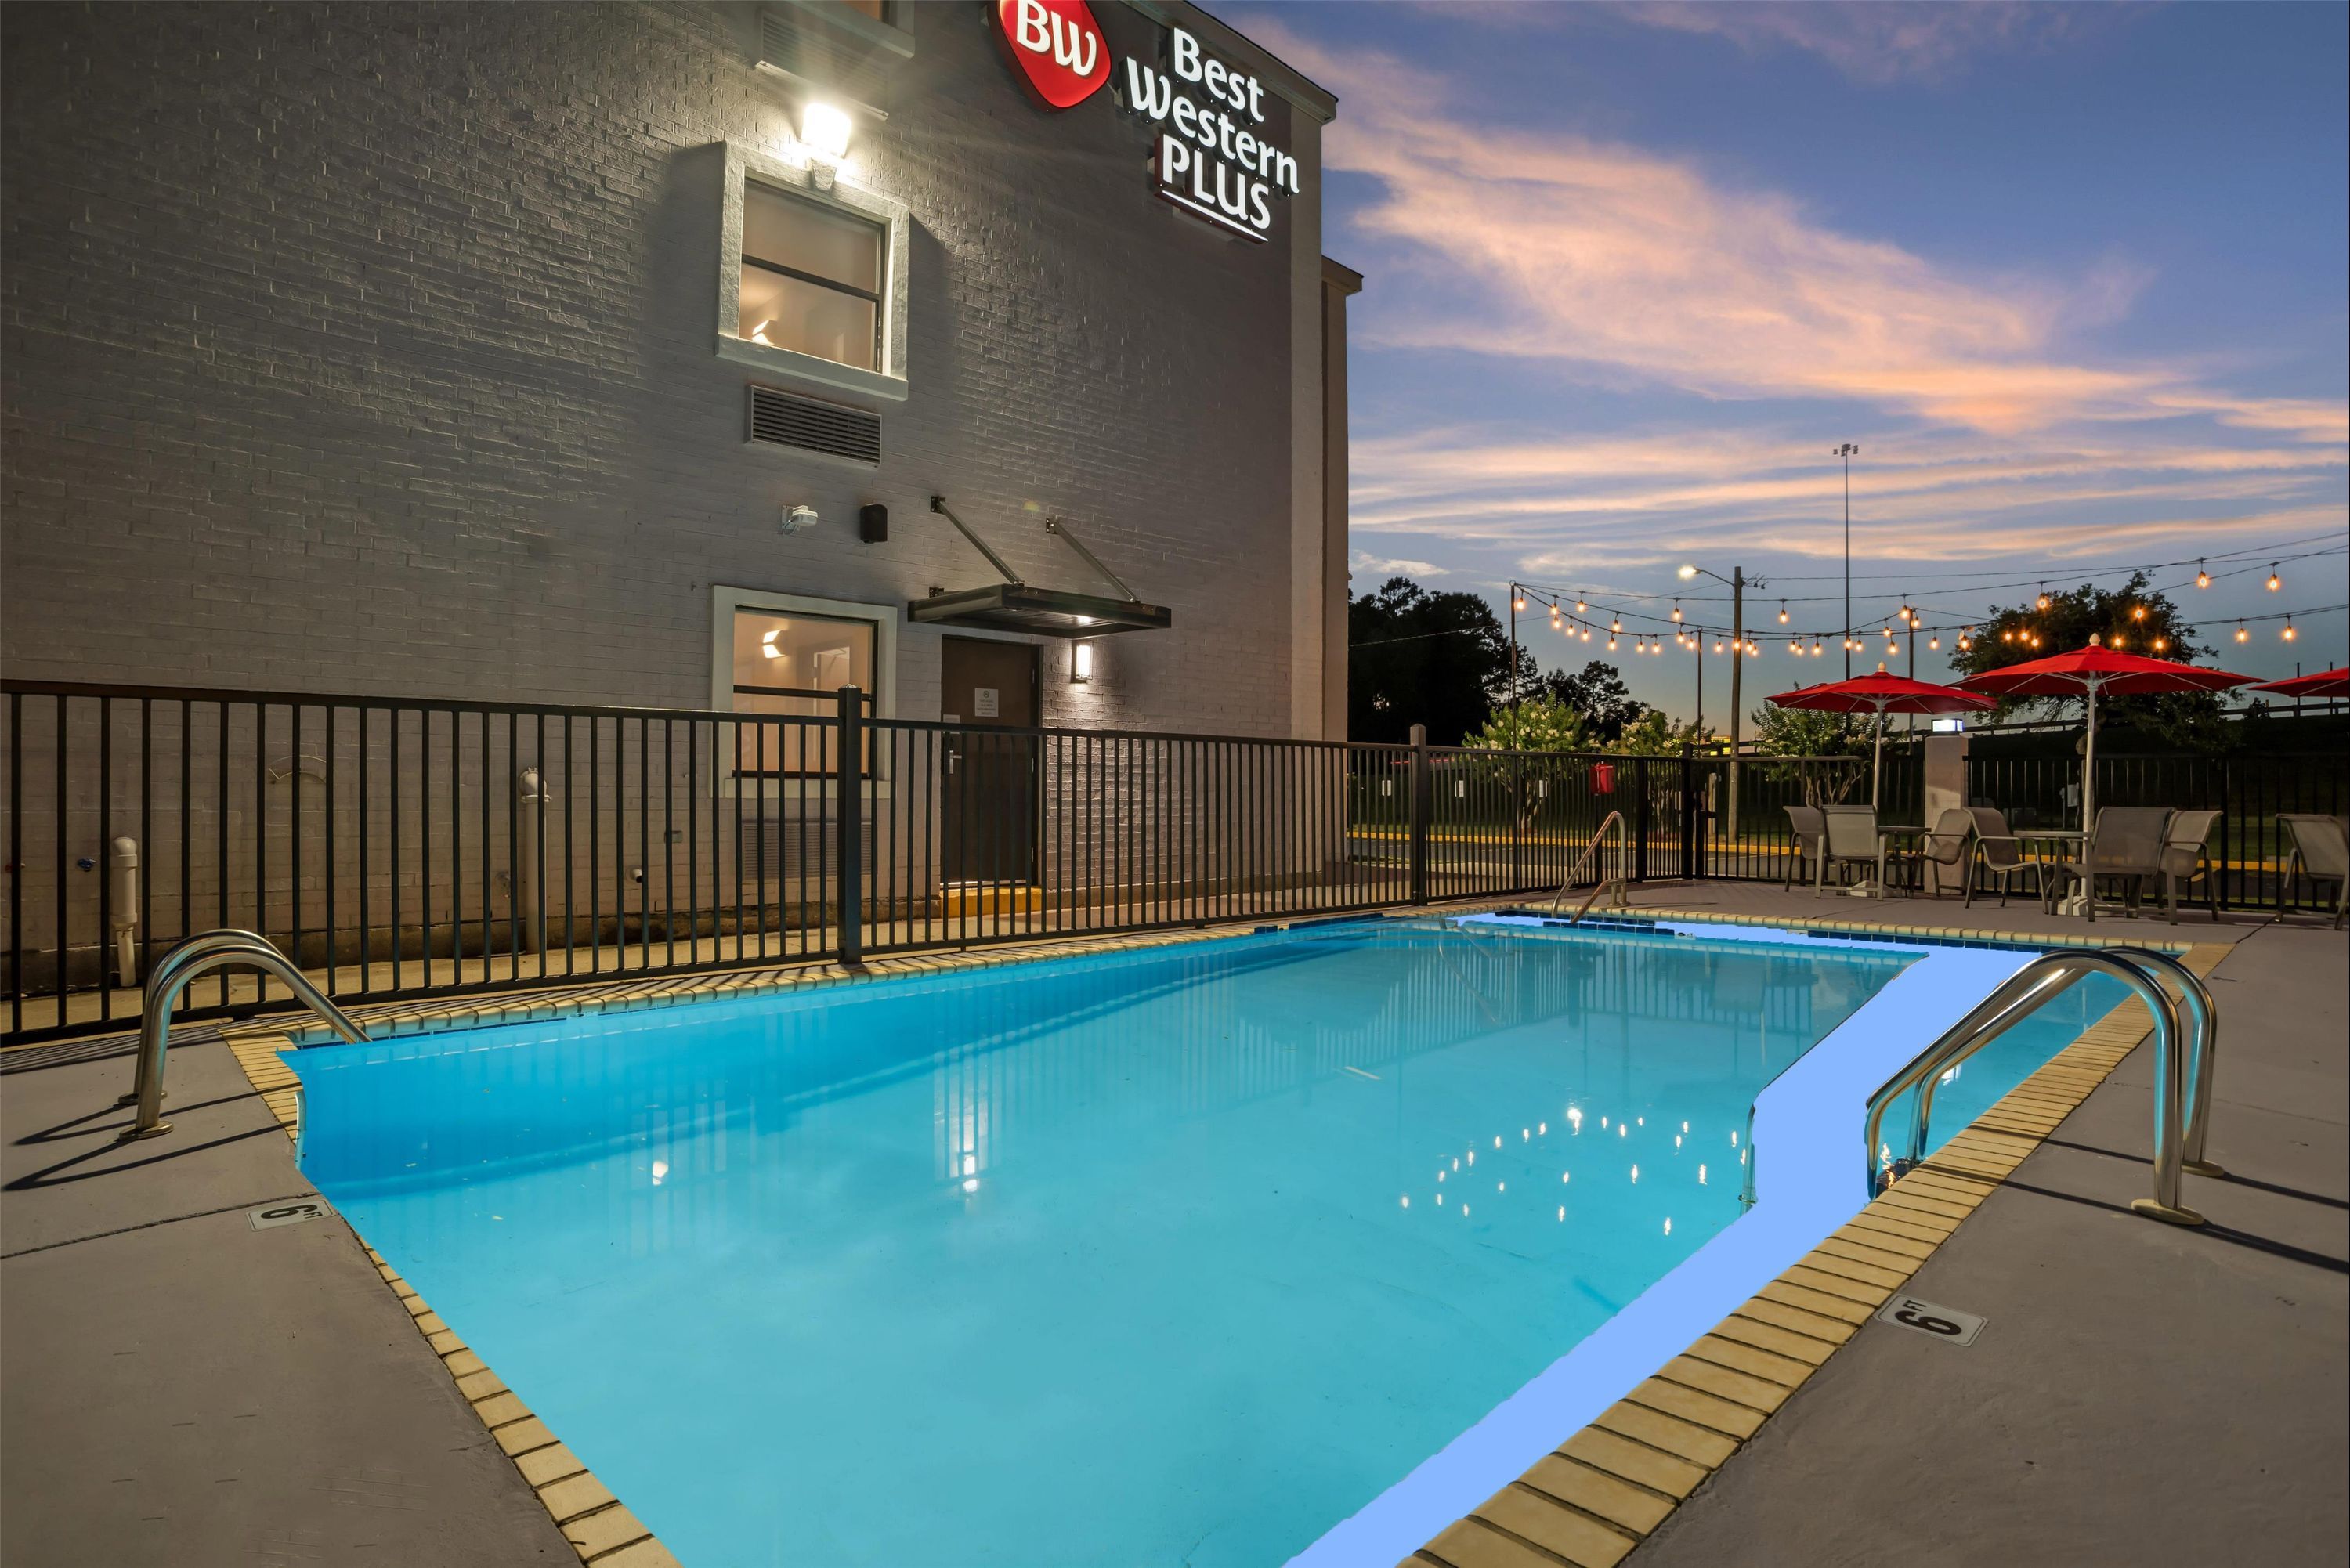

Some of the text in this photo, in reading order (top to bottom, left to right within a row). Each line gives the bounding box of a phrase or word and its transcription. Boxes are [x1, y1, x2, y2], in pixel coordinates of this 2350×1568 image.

[1017, 0, 1097, 76] BW
[1174, 27, 1264, 122] Best
[1126, 56, 1300, 194] Western
[1895, 1310, 1962, 1335] 6
